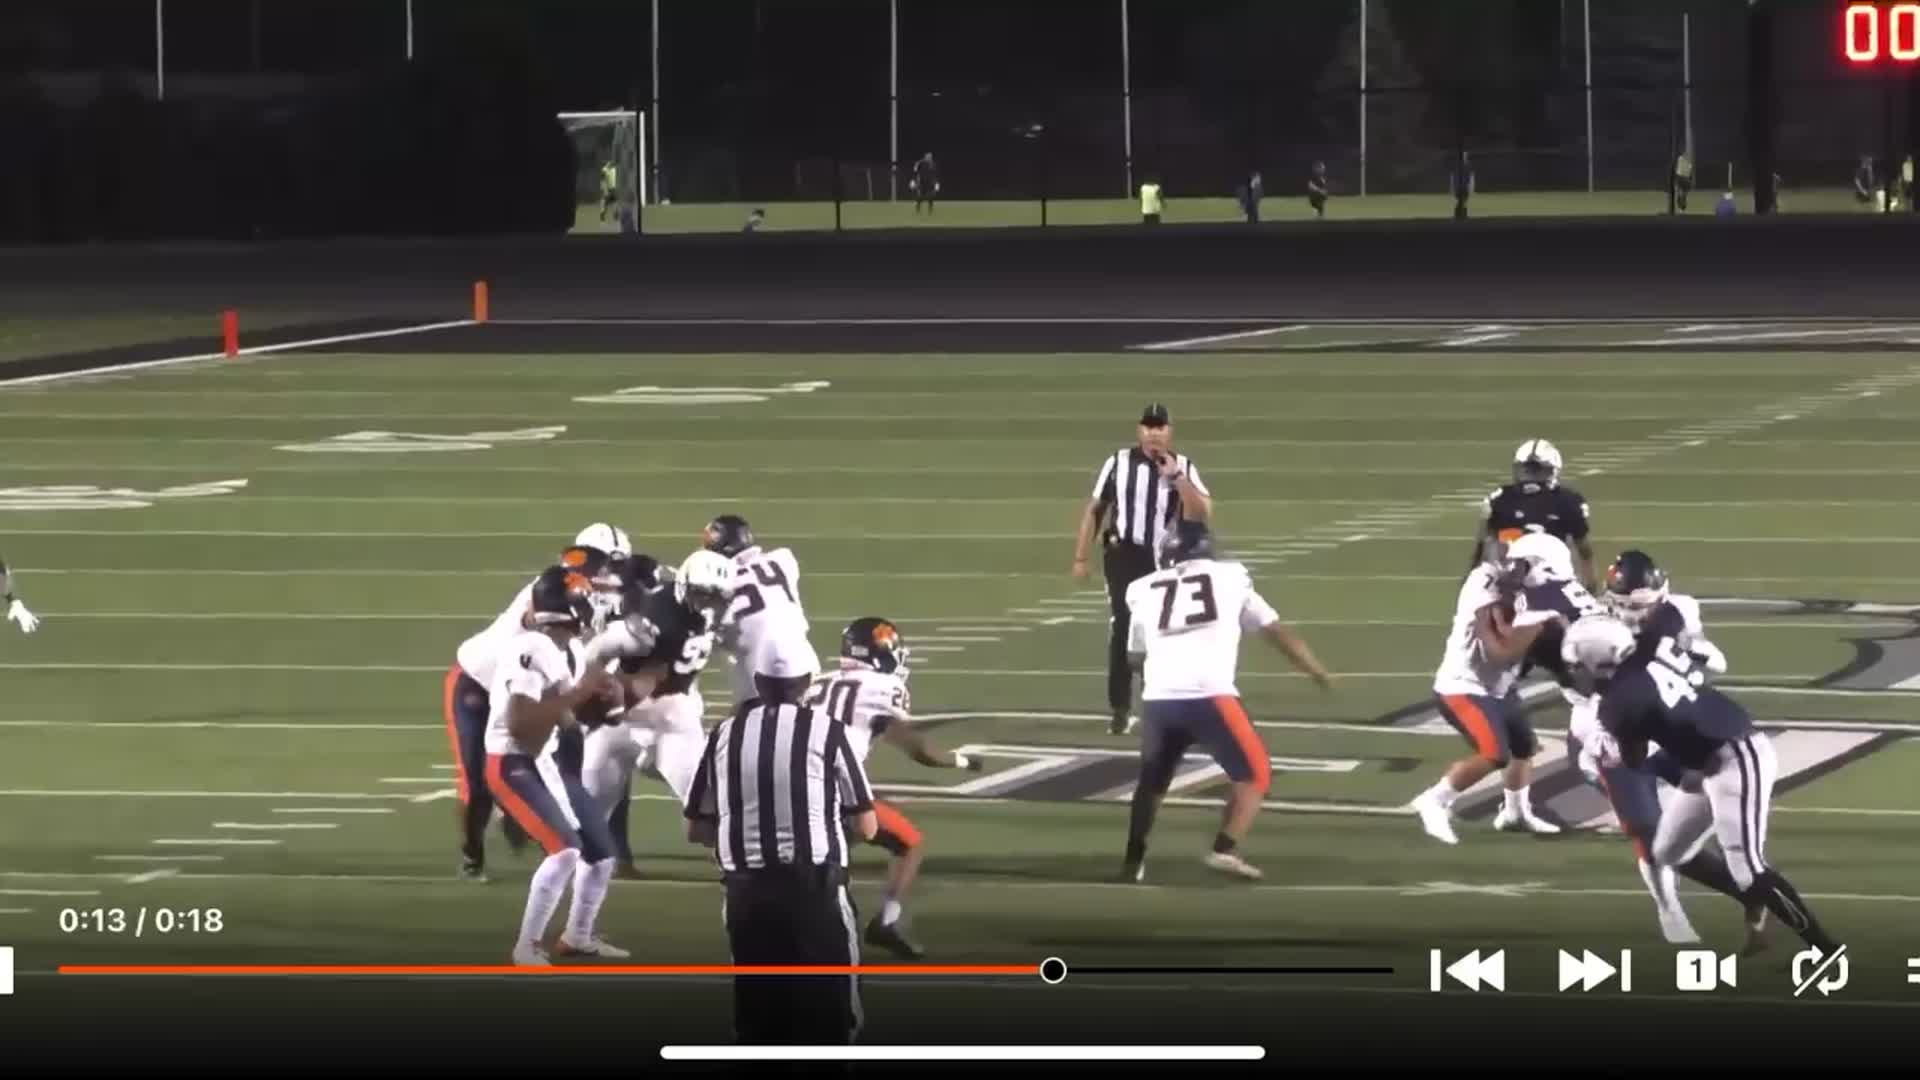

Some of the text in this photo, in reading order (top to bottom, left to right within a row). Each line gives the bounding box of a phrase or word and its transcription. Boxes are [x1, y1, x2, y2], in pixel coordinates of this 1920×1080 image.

[1846, 5, 1920, 61] 00
[1150, 573, 1218, 631] 73
[1646, 635, 1704, 709] 45
